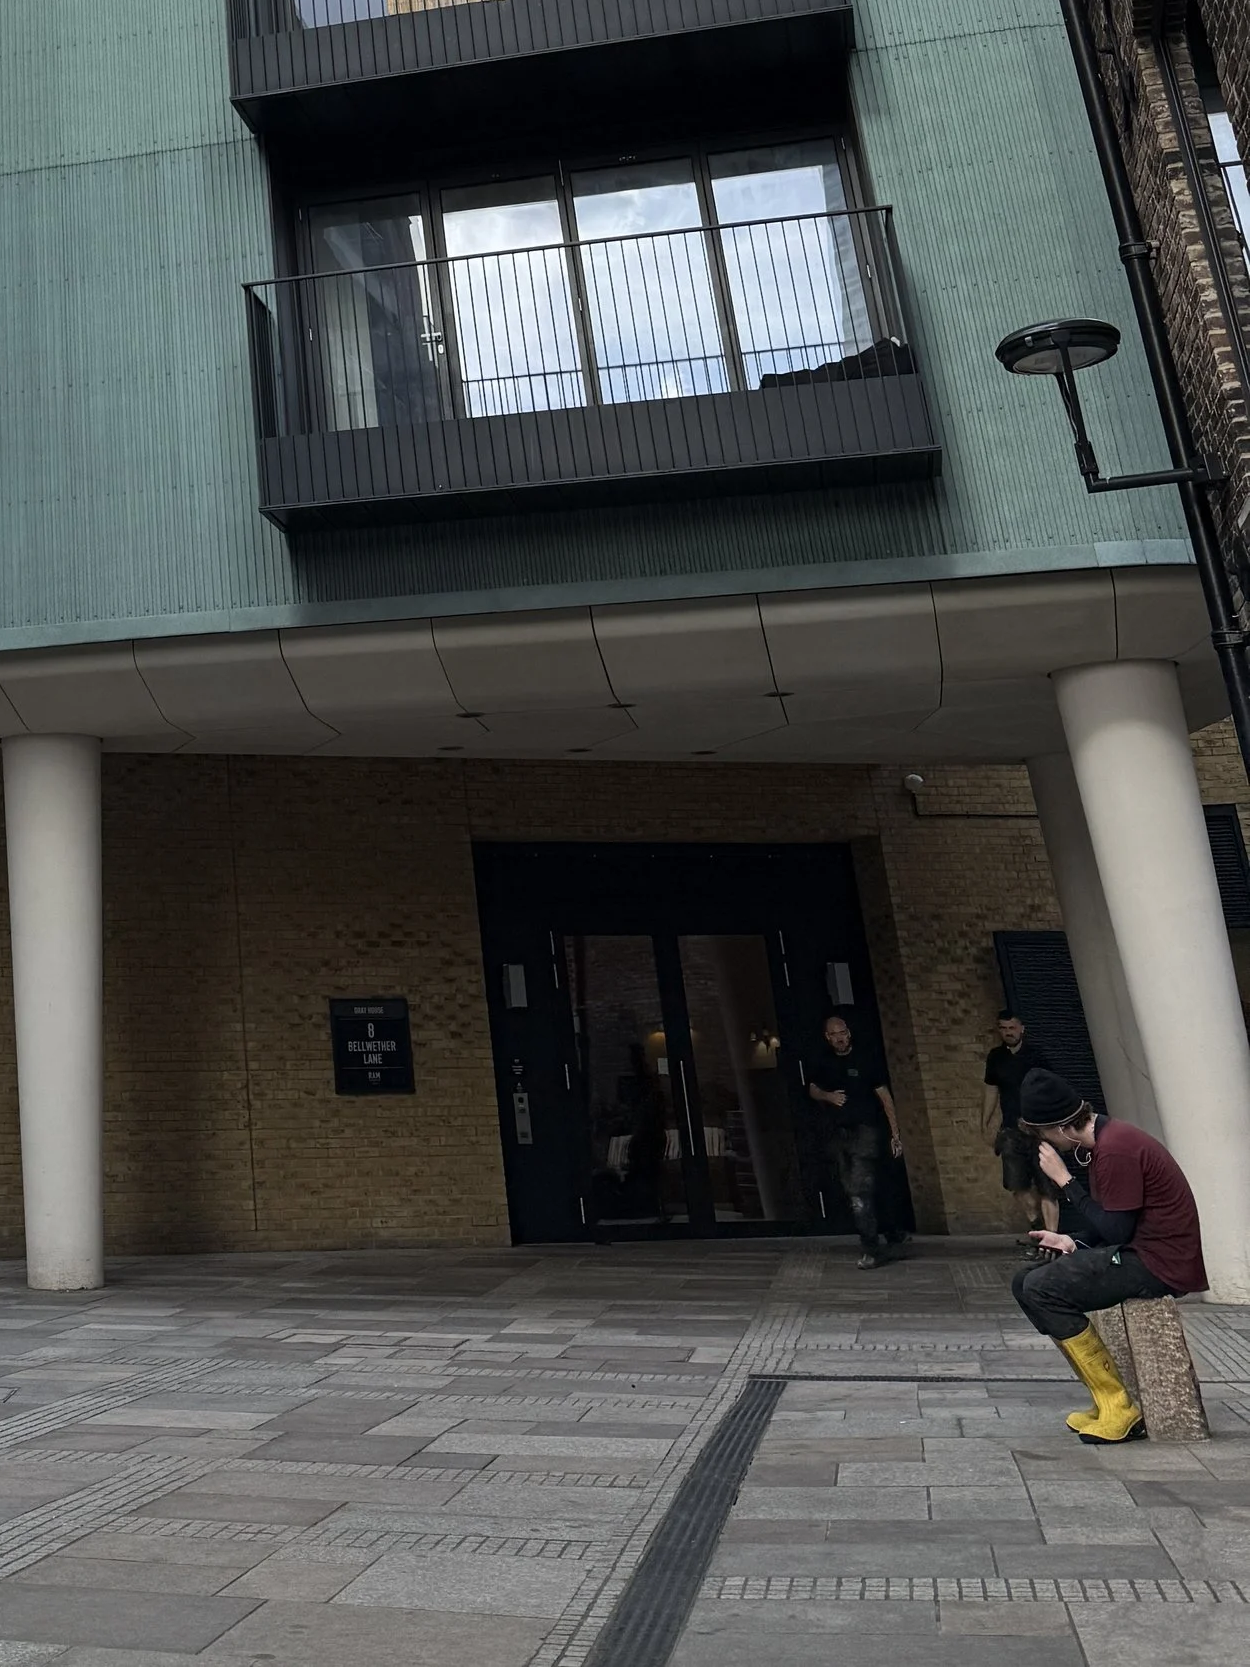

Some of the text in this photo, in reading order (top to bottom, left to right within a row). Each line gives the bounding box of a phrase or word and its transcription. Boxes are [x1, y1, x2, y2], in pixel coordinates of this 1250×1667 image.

[367, 1022, 375, 1039] 8
[348, 1040, 397, 1052] BELLWETHER
[363, 1053, 383, 1064] LANE
